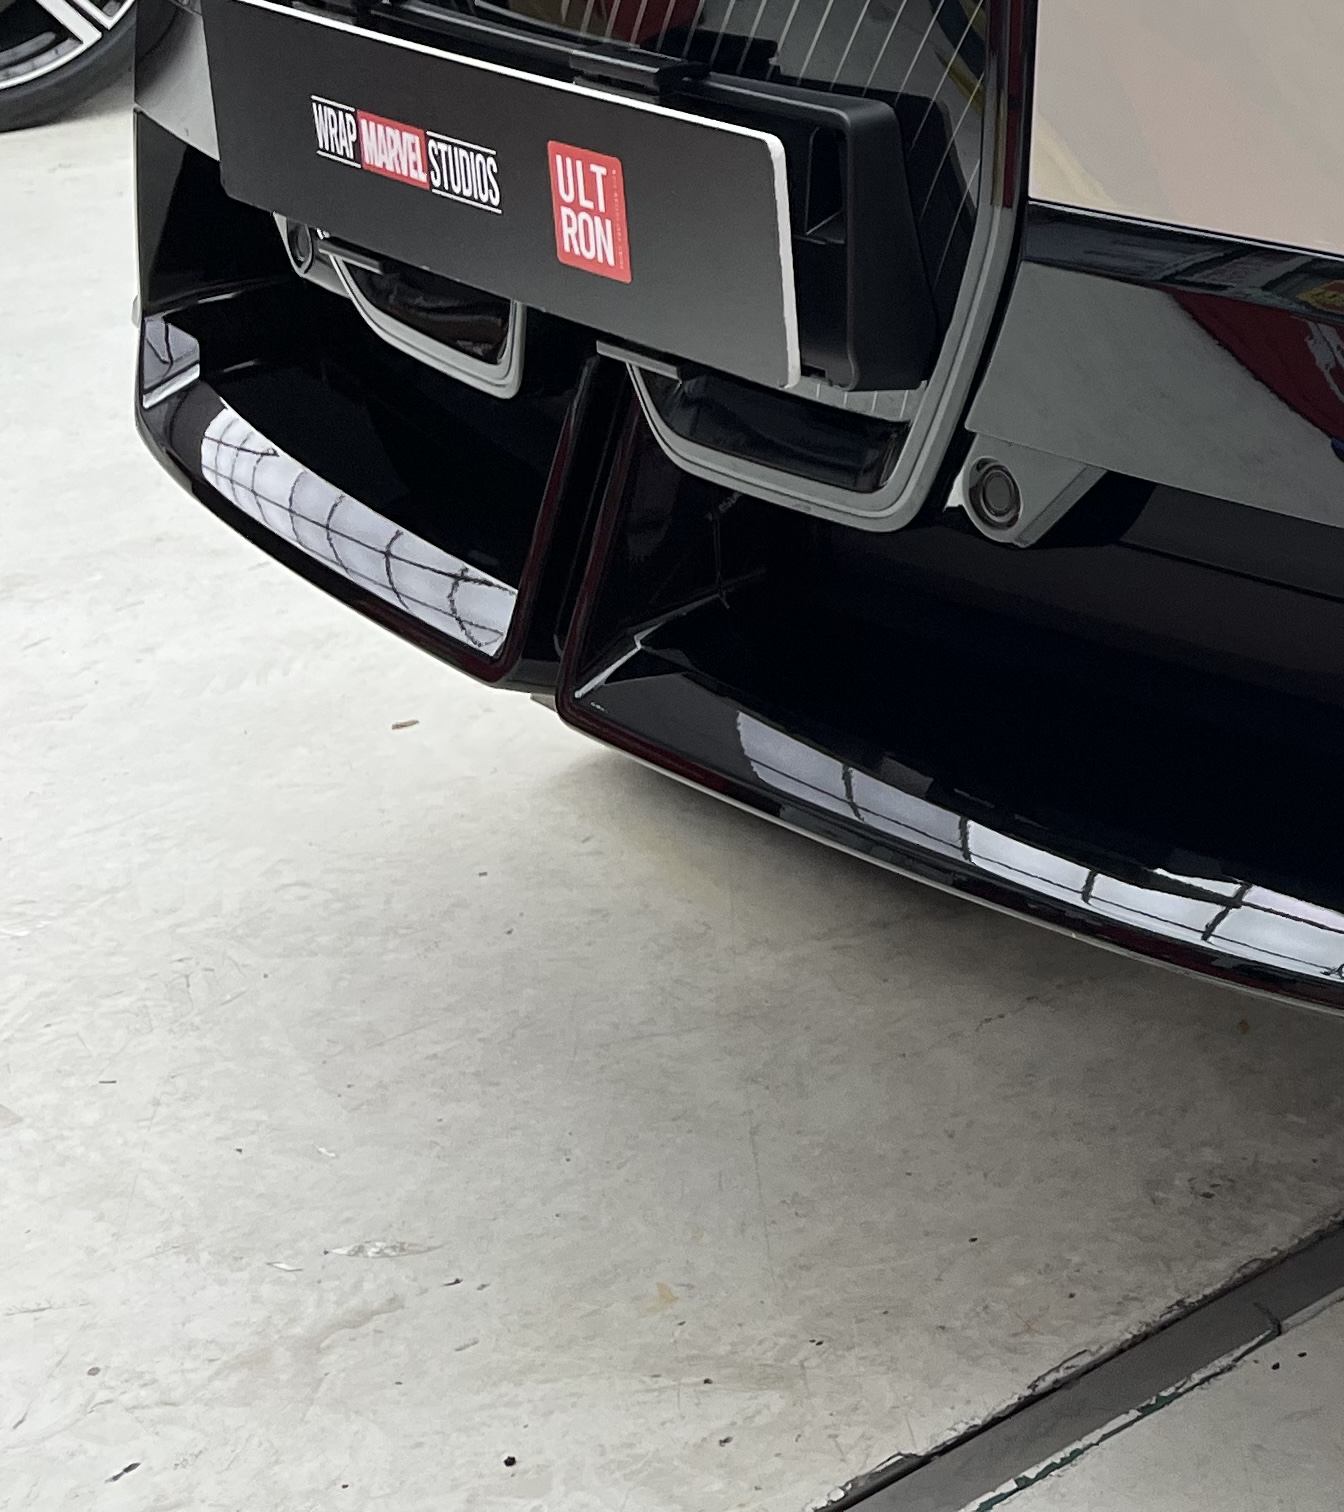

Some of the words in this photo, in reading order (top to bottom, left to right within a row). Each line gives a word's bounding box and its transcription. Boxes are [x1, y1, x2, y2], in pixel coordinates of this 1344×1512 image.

[312, 102, 357, 159] WRAP
[361, 118, 427, 183] MARVEL
[428, 139, 500, 206] STUDIOS
[555, 154, 607, 213] ULT
[560, 205, 615, 267] RON
